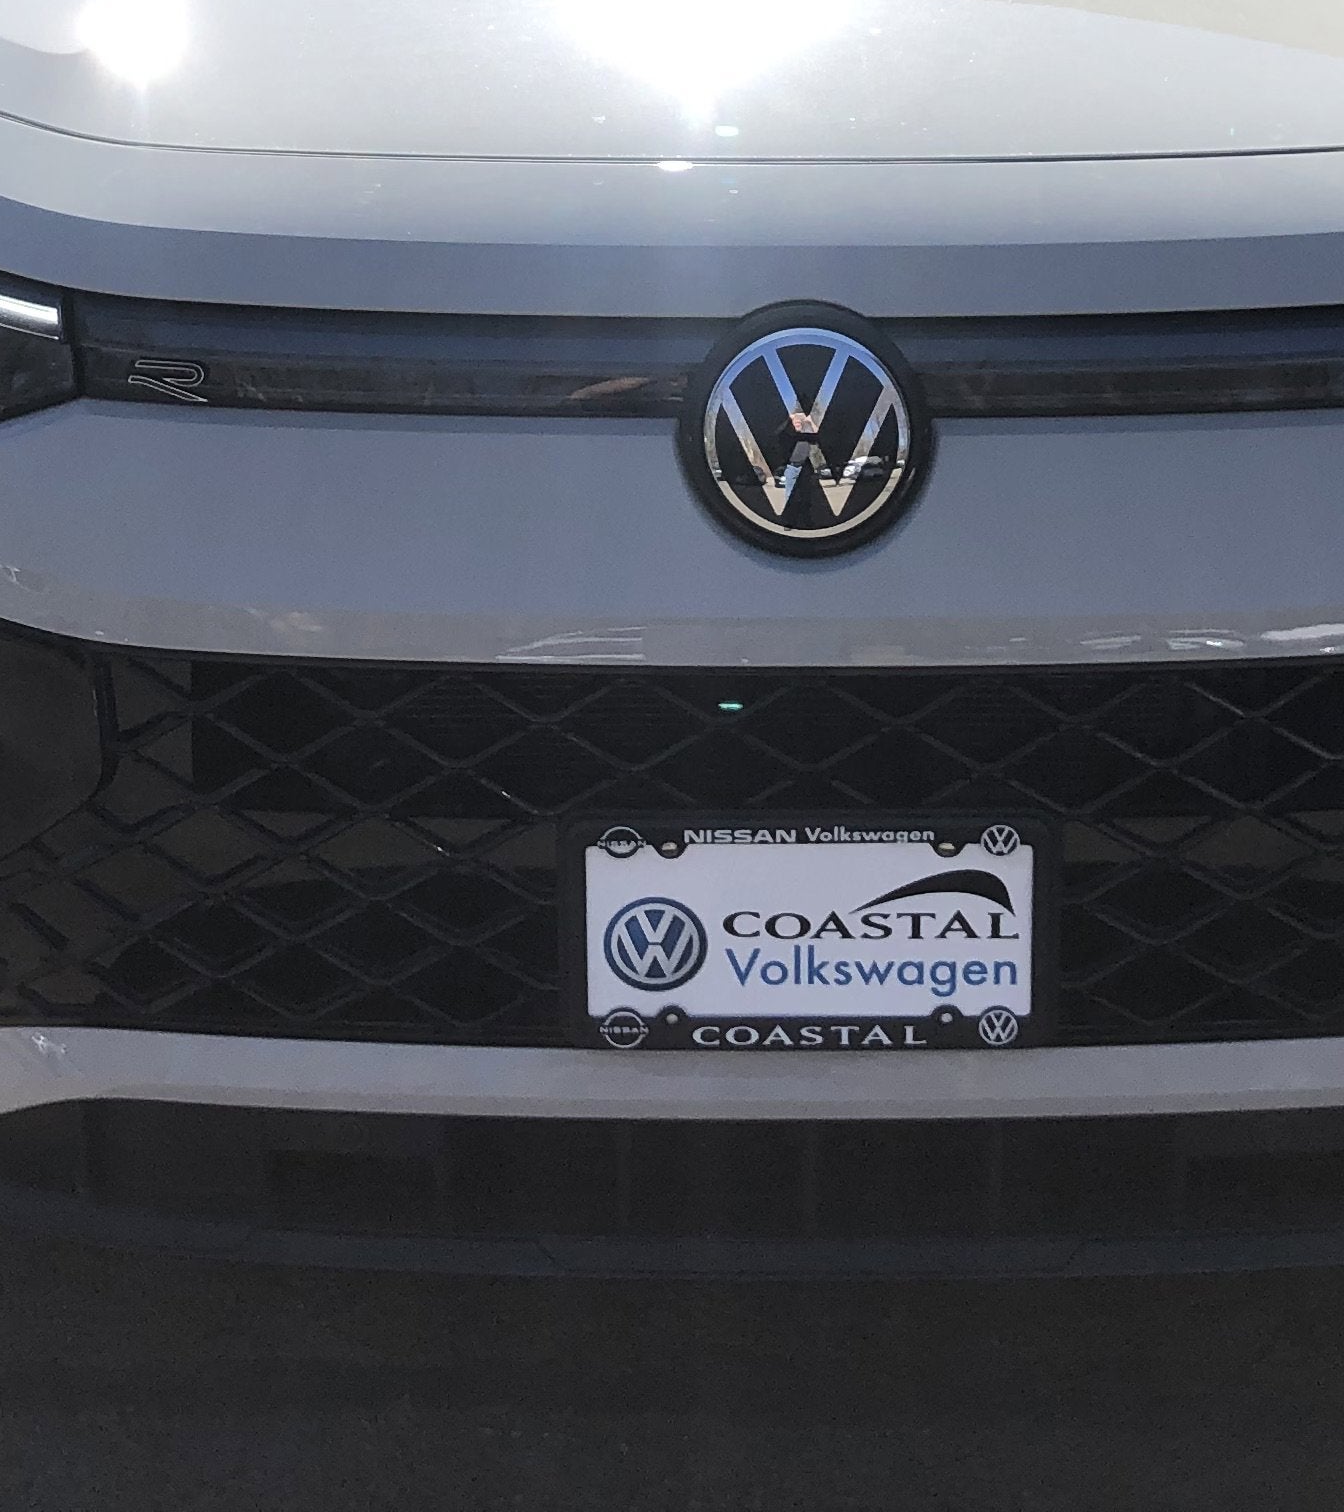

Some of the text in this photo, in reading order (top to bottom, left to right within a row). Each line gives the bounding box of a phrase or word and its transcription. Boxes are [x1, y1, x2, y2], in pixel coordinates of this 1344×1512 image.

[684, 825, 936, 844] NISSAN Volkswagen
[722, 910, 1020, 940] COASTAL
[725, 945, 1019, 997] Volkswagen
[692, 1024, 928, 1047] COASTAL
